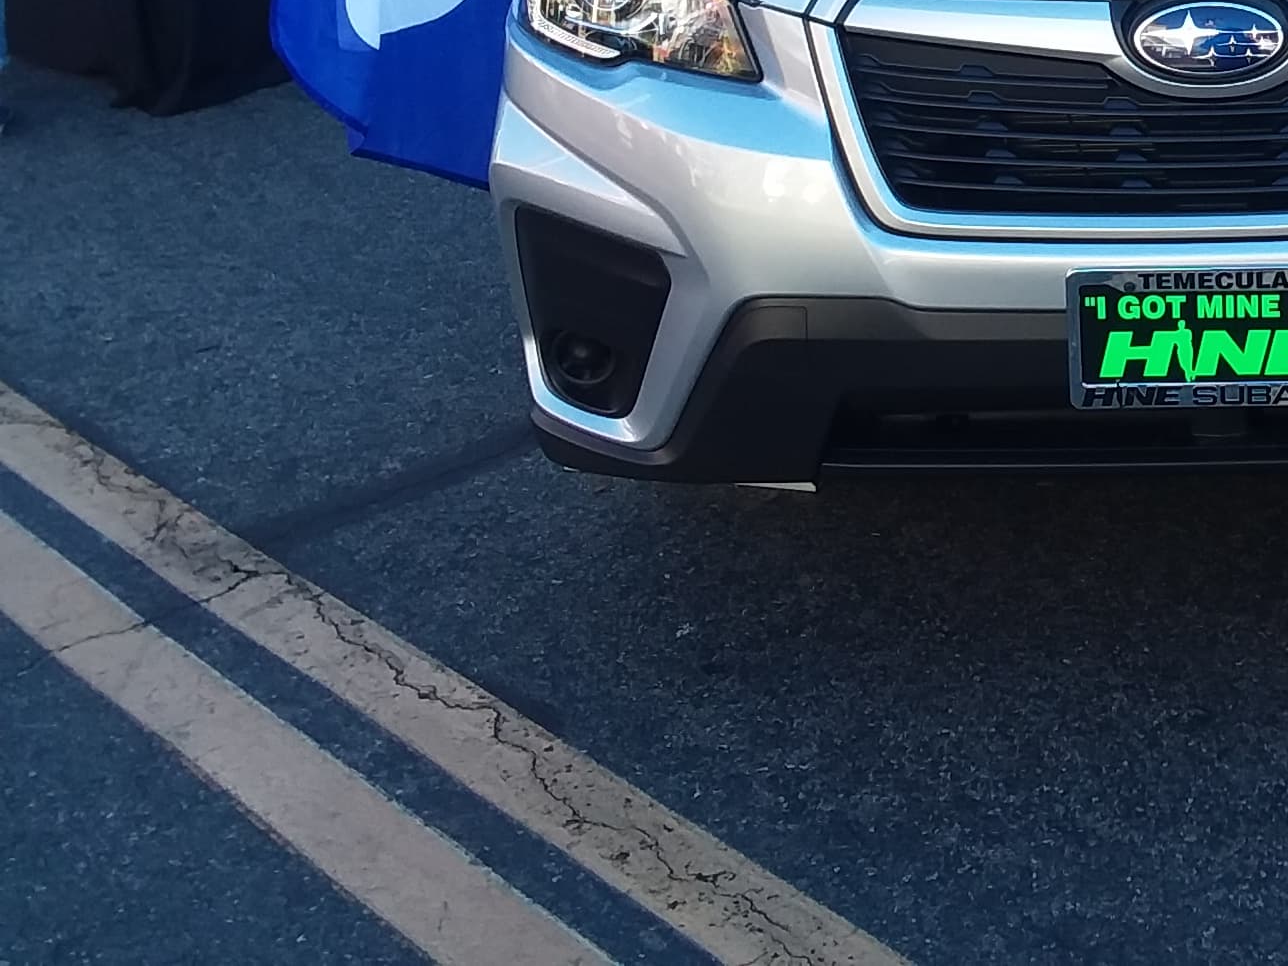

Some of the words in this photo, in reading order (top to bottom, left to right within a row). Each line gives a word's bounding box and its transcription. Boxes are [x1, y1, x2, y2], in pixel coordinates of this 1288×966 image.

[1084, 295, 1107, 320] "I
[1117, 295, 1187, 319] GOT
[1197, 294, 1282, 319] MINE
[1082, 381, 1181, 408] HINE
